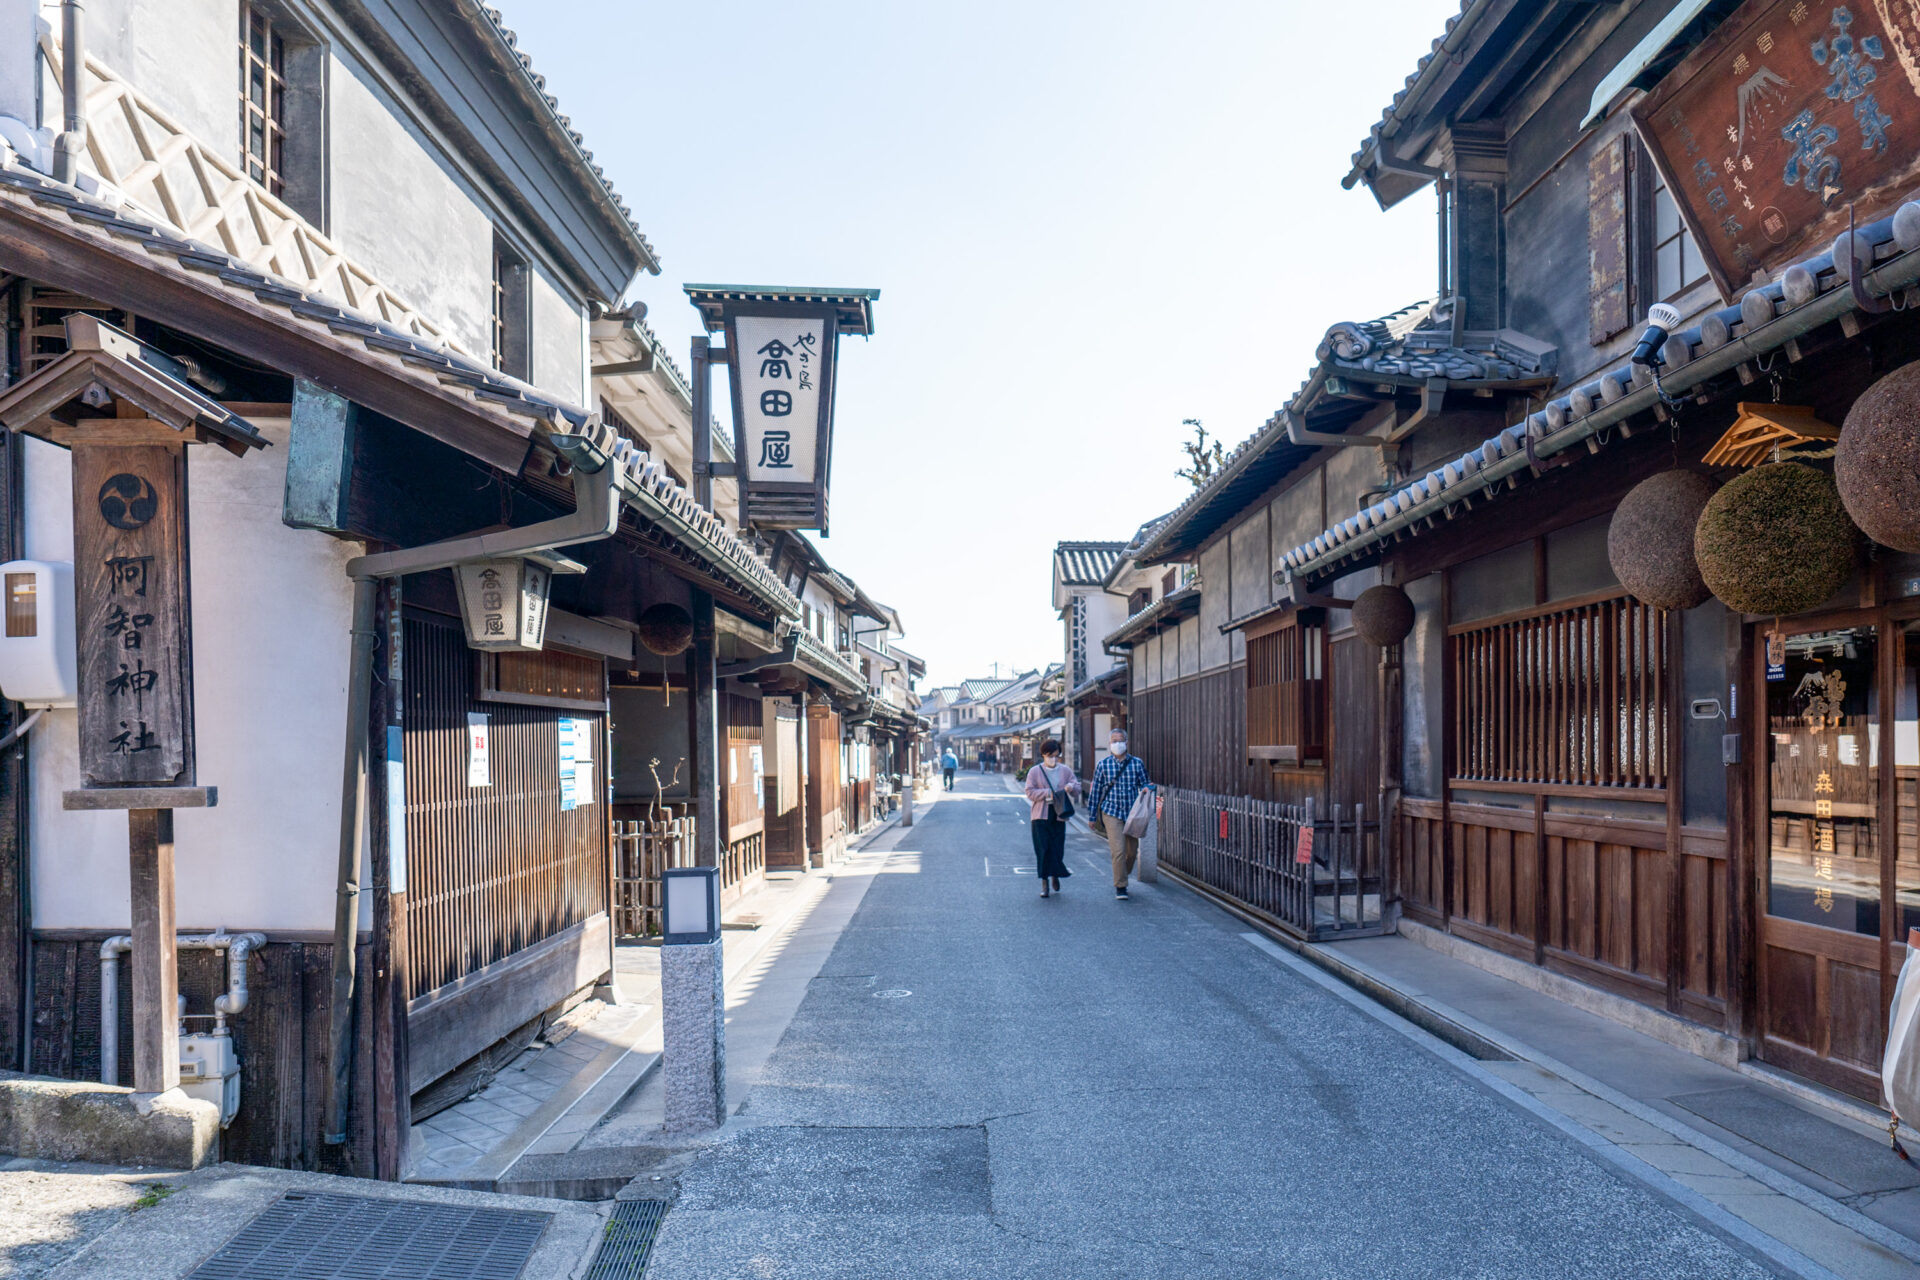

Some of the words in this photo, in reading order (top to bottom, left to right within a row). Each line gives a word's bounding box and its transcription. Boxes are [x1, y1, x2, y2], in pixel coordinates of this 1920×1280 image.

[104, 555, 162, 757] 阿智神社
[1813, 770, 1834, 913] 森田酒造場
